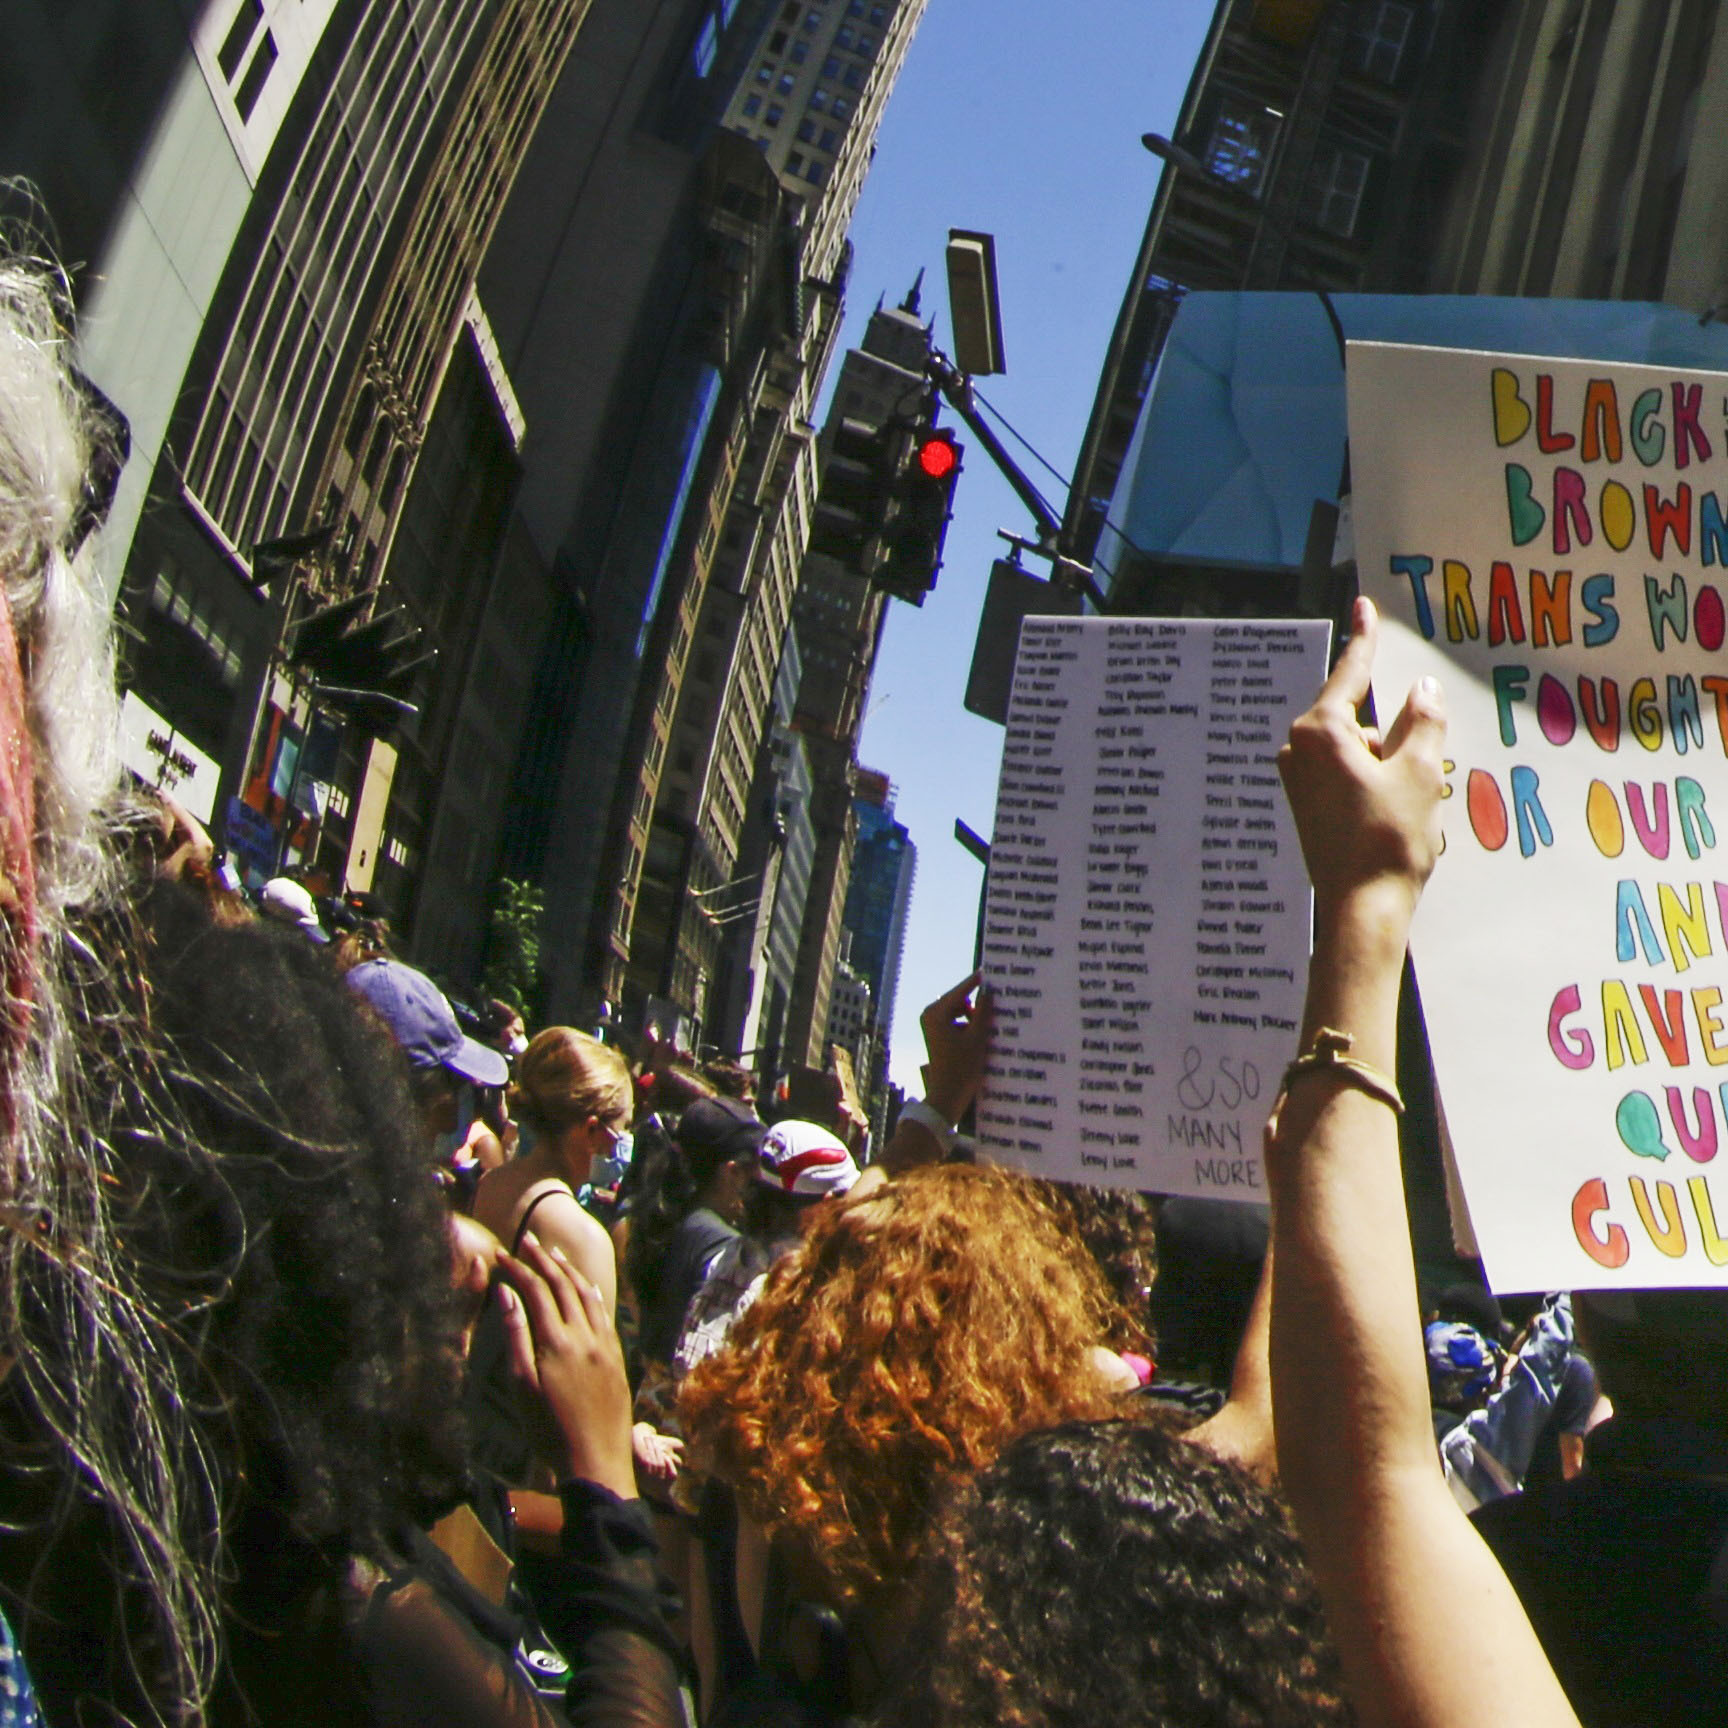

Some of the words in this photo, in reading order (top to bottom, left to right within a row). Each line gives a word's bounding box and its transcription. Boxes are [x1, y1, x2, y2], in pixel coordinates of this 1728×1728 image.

[1491, 367, 1712, 469] BLACK
[1390, 554, 1622, 649] TRANS
[1439, 759, 1555, 858] OR
[1585, 775, 1717, 861] OUR
[1177, 1045, 1215, 1110] &
[1221, 1057, 1260, 1112] SO
[1168, 1113, 1245, 1155] MANY
[1195, 1157, 1260, 1188] MORE
